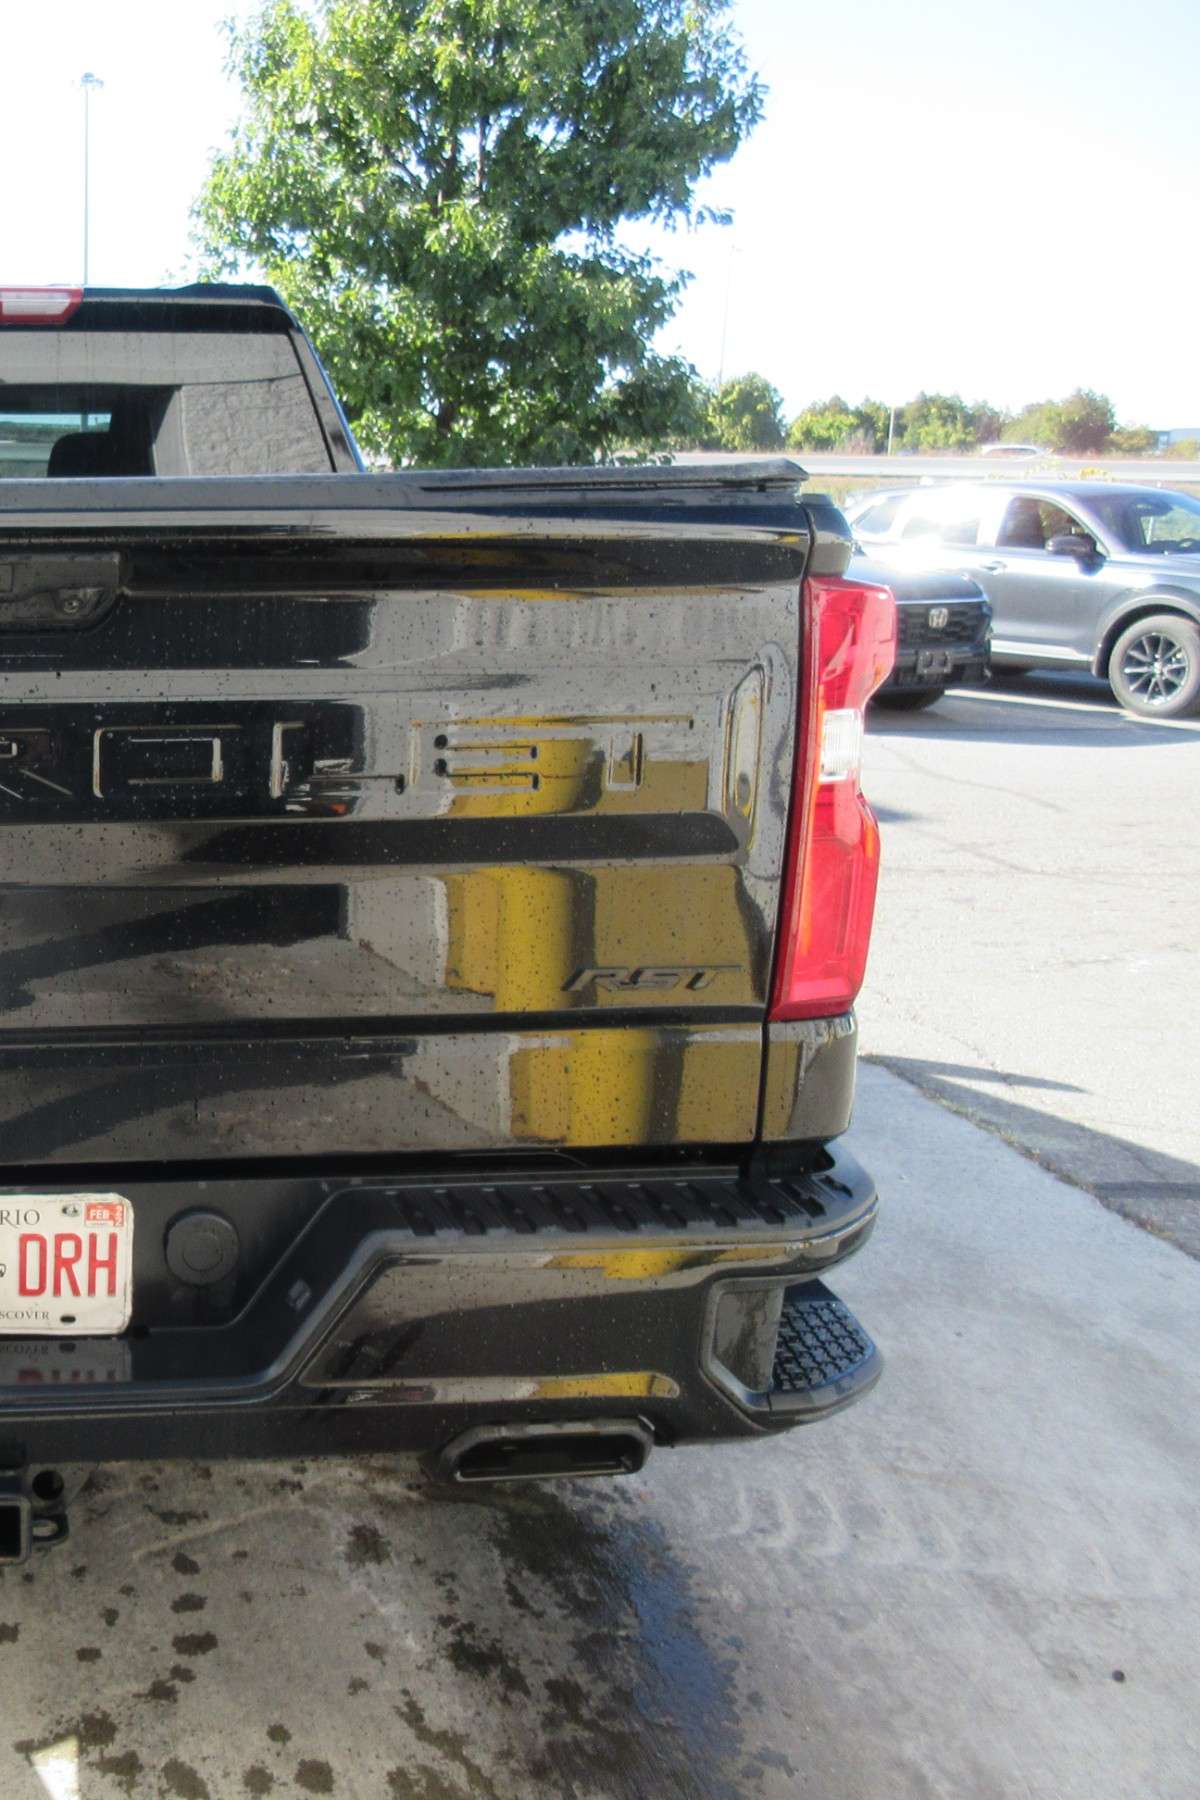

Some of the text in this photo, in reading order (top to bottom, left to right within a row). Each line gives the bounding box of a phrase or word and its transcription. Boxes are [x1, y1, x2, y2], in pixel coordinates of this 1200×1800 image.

[560, 964, 743, 993] RST
[89, 1209, 110, 1221] FEB
[17, 1232, 118, 1298] DRH
